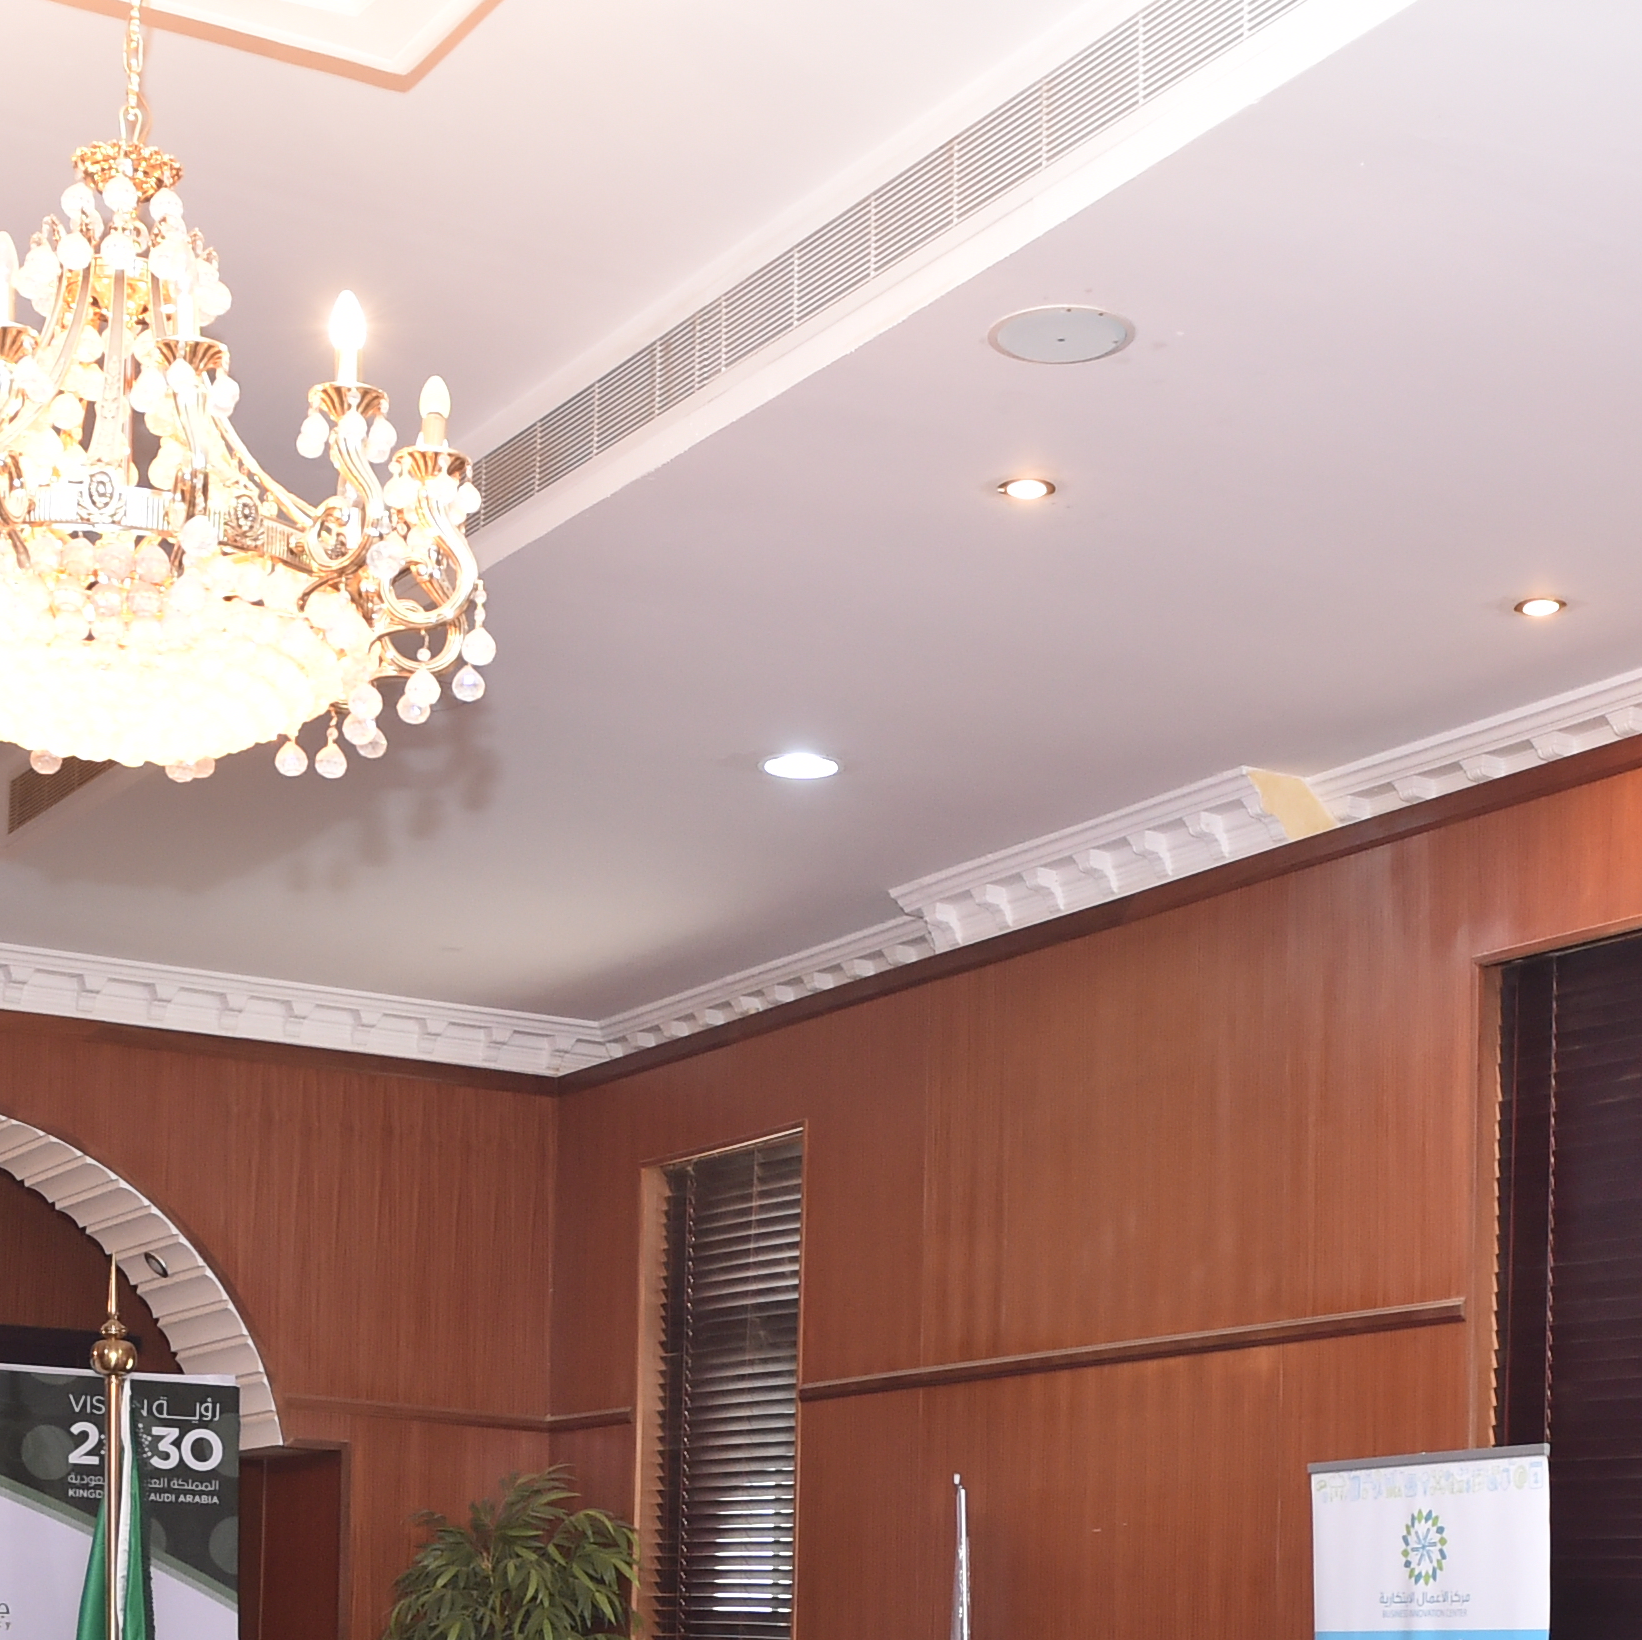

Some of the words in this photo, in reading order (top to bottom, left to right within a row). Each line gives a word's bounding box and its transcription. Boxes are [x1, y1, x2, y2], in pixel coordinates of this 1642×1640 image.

[170, 1477, 220, 1491] المملكة
[68, 1488, 104, 1499] KINGD
[147, 1492, 175, 1503] AUDI
[178, 1493, 220, 1504] ARABIA
